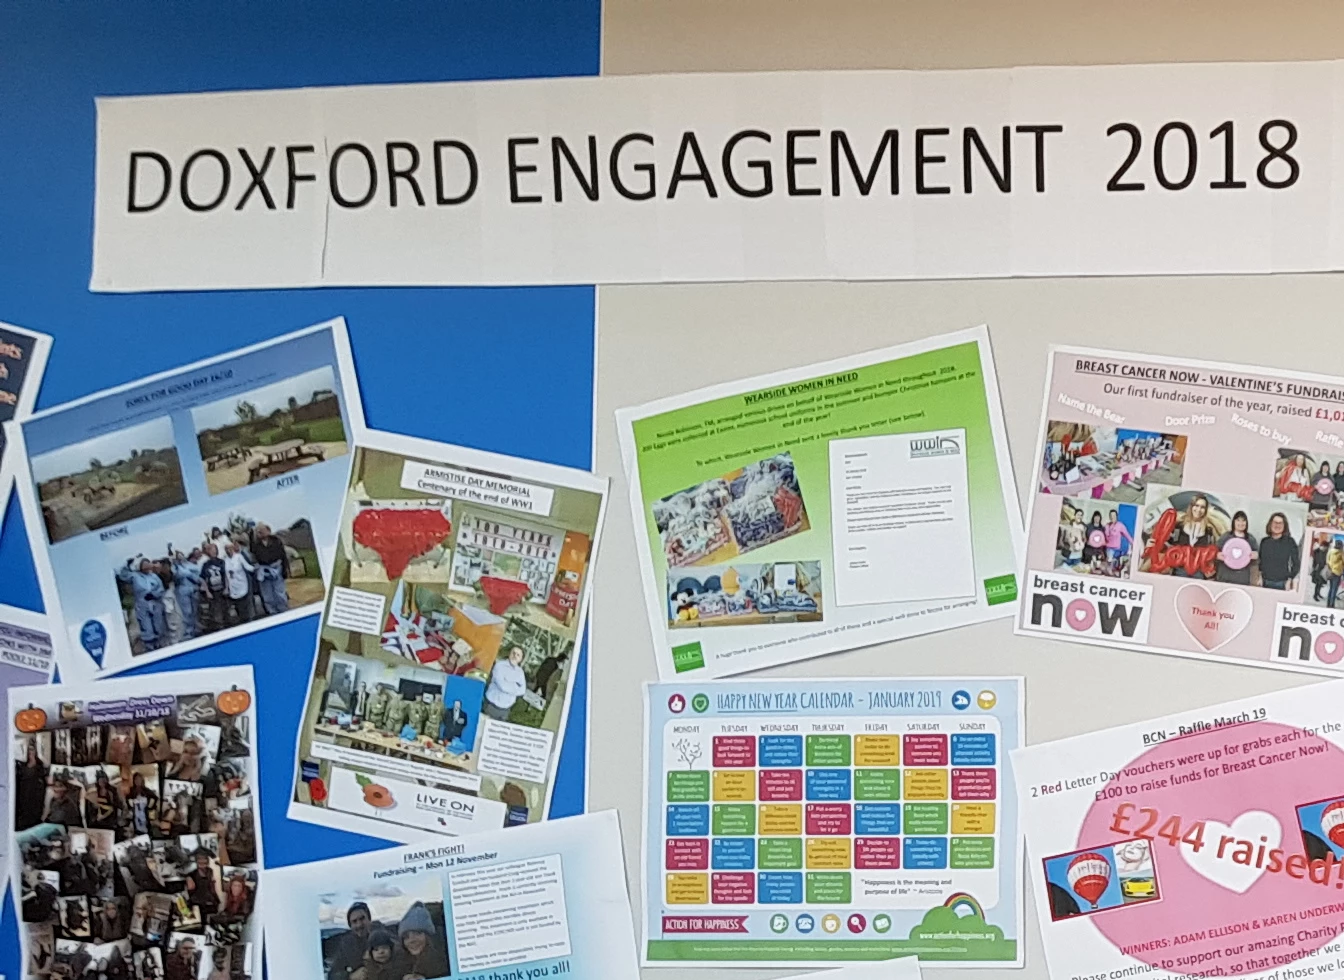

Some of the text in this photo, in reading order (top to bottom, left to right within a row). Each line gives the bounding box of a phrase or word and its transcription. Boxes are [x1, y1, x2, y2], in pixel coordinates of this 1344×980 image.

[127, 140, 478, 212] DOXFORD
[507, 124, 1063, 203] ENGAGEMENT
[1106, 119, 1299, 191] 2018
[1075, 359, 1119, 375] BREAST
[1120, 364, 1166, 379] CANCER
[1168, 370, 1199, 385] NOW
[1103, 382, 1125, 394] Our
[1127, 384, 1148, 398] first
[1151, 387, 1208, 404] fundraiser
[1210, 394, 1222, 406] of
[1225, 396, 1243, 408] the
[1246, 401, 1273, 414] year,
[1276, 403, 1312, 417] raised
[1033, 576, 1145, 601] breast cancer
[1031, 593, 1143, 638] now
[1282, 607, 1334, 626] breast
[717, 693, 748, 709] HAPPY
[749, 693, 773, 709] NEW
[773, 693, 798, 709] YEAR
[801, 692, 854, 709] CALENDAR
[868, 691, 915, 708] JANUARY
[917, 691, 942, 708] 2019
[1142, 730, 1166, 744] BCN
[1178, 720, 1211, 736] Raffle
[1213, 711, 1249, 727] March
[1252, 707, 1266, 719] 19
[1109, 802, 1205, 853] £244
[1119, 938, 1171, 955] WINNERS:
[1173, 930, 1206, 945] ADAM
[1208, 922, 1249, 938] ELLISON
[1251, 919, 1260, 929] &
[1261, 912, 1297, 927] KAREN
[551, 959, 570, 974] all!
